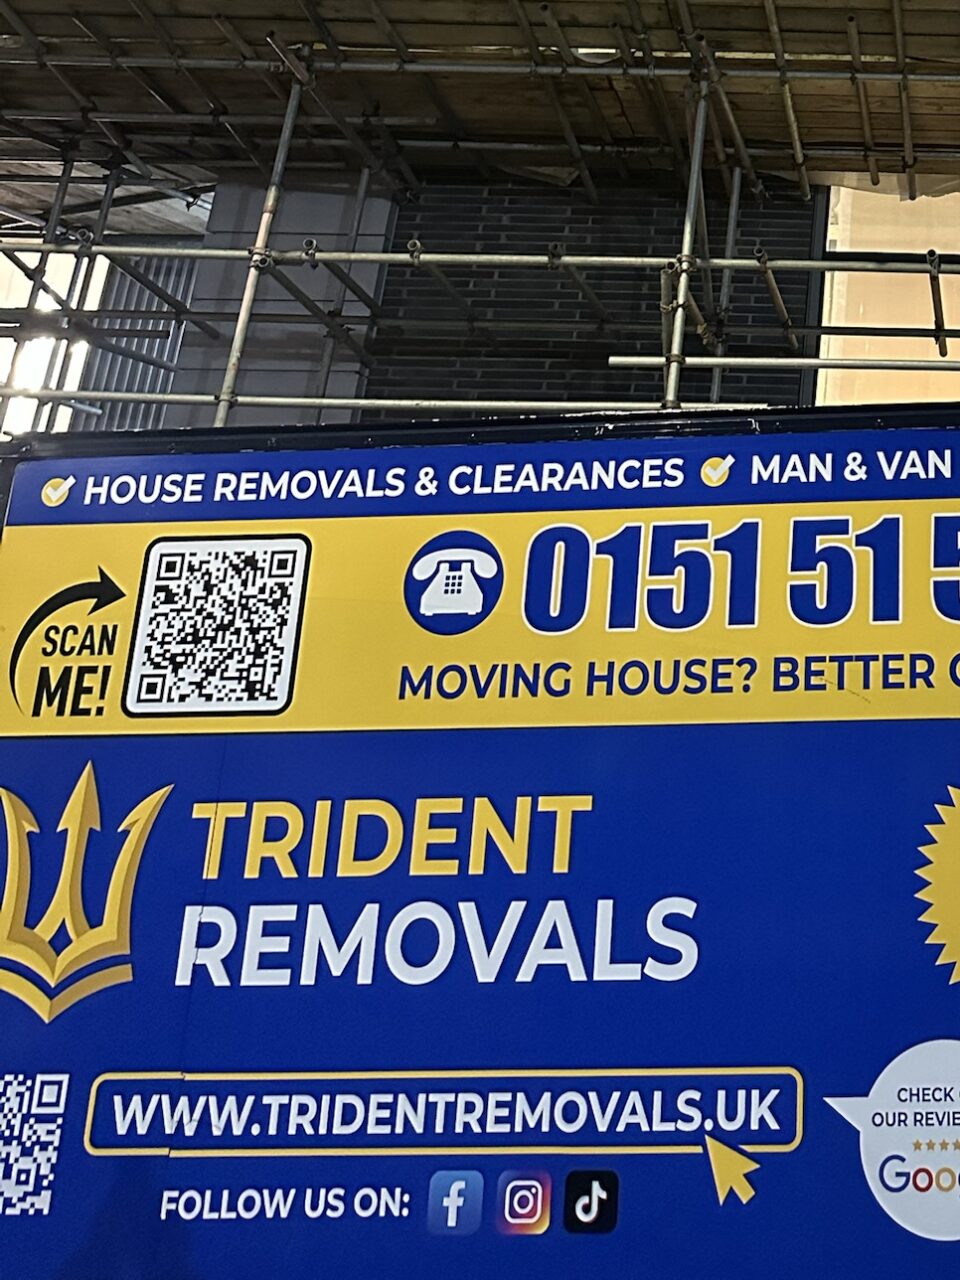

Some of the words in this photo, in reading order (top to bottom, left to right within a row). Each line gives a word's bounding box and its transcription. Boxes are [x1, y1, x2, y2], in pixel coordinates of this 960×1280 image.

[84, 474, 205, 504] HOUSE
[214, 468, 405, 501] REMOVALS
[415, 467, 437, 496] &
[449, 458, 684, 495] CLEARANCES
[752, 453, 832, 484] MAN
[844, 452, 867, 481] &
[877, 450, 951, 480] VAN
[524, 522, 759, 632] 0151
[790, 517, 900, 625] 51
[42, 625, 117, 656] SCAN
[32, 666, 111, 717] ME!
[399, 662, 571, 700] MOVING
[587, 658, 757, 696] HOUSE?
[773, 654, 934, 691] BETTER
[192, 795, 592, 879] TRIDENT
[175, 897, 698, 986] REMOVALS
[114, 1089, 780, 1136] WWW.TRIDENTREMOVALS.UK
[898, 1087, 954, 1102] CHECK
[872, 1112, 907, 1126] OUR
[161, 1189, 296, 1219] FOLLOW
[305, 1188, 345, 1218] US
[354, 1188, 409, 1217] ON:
